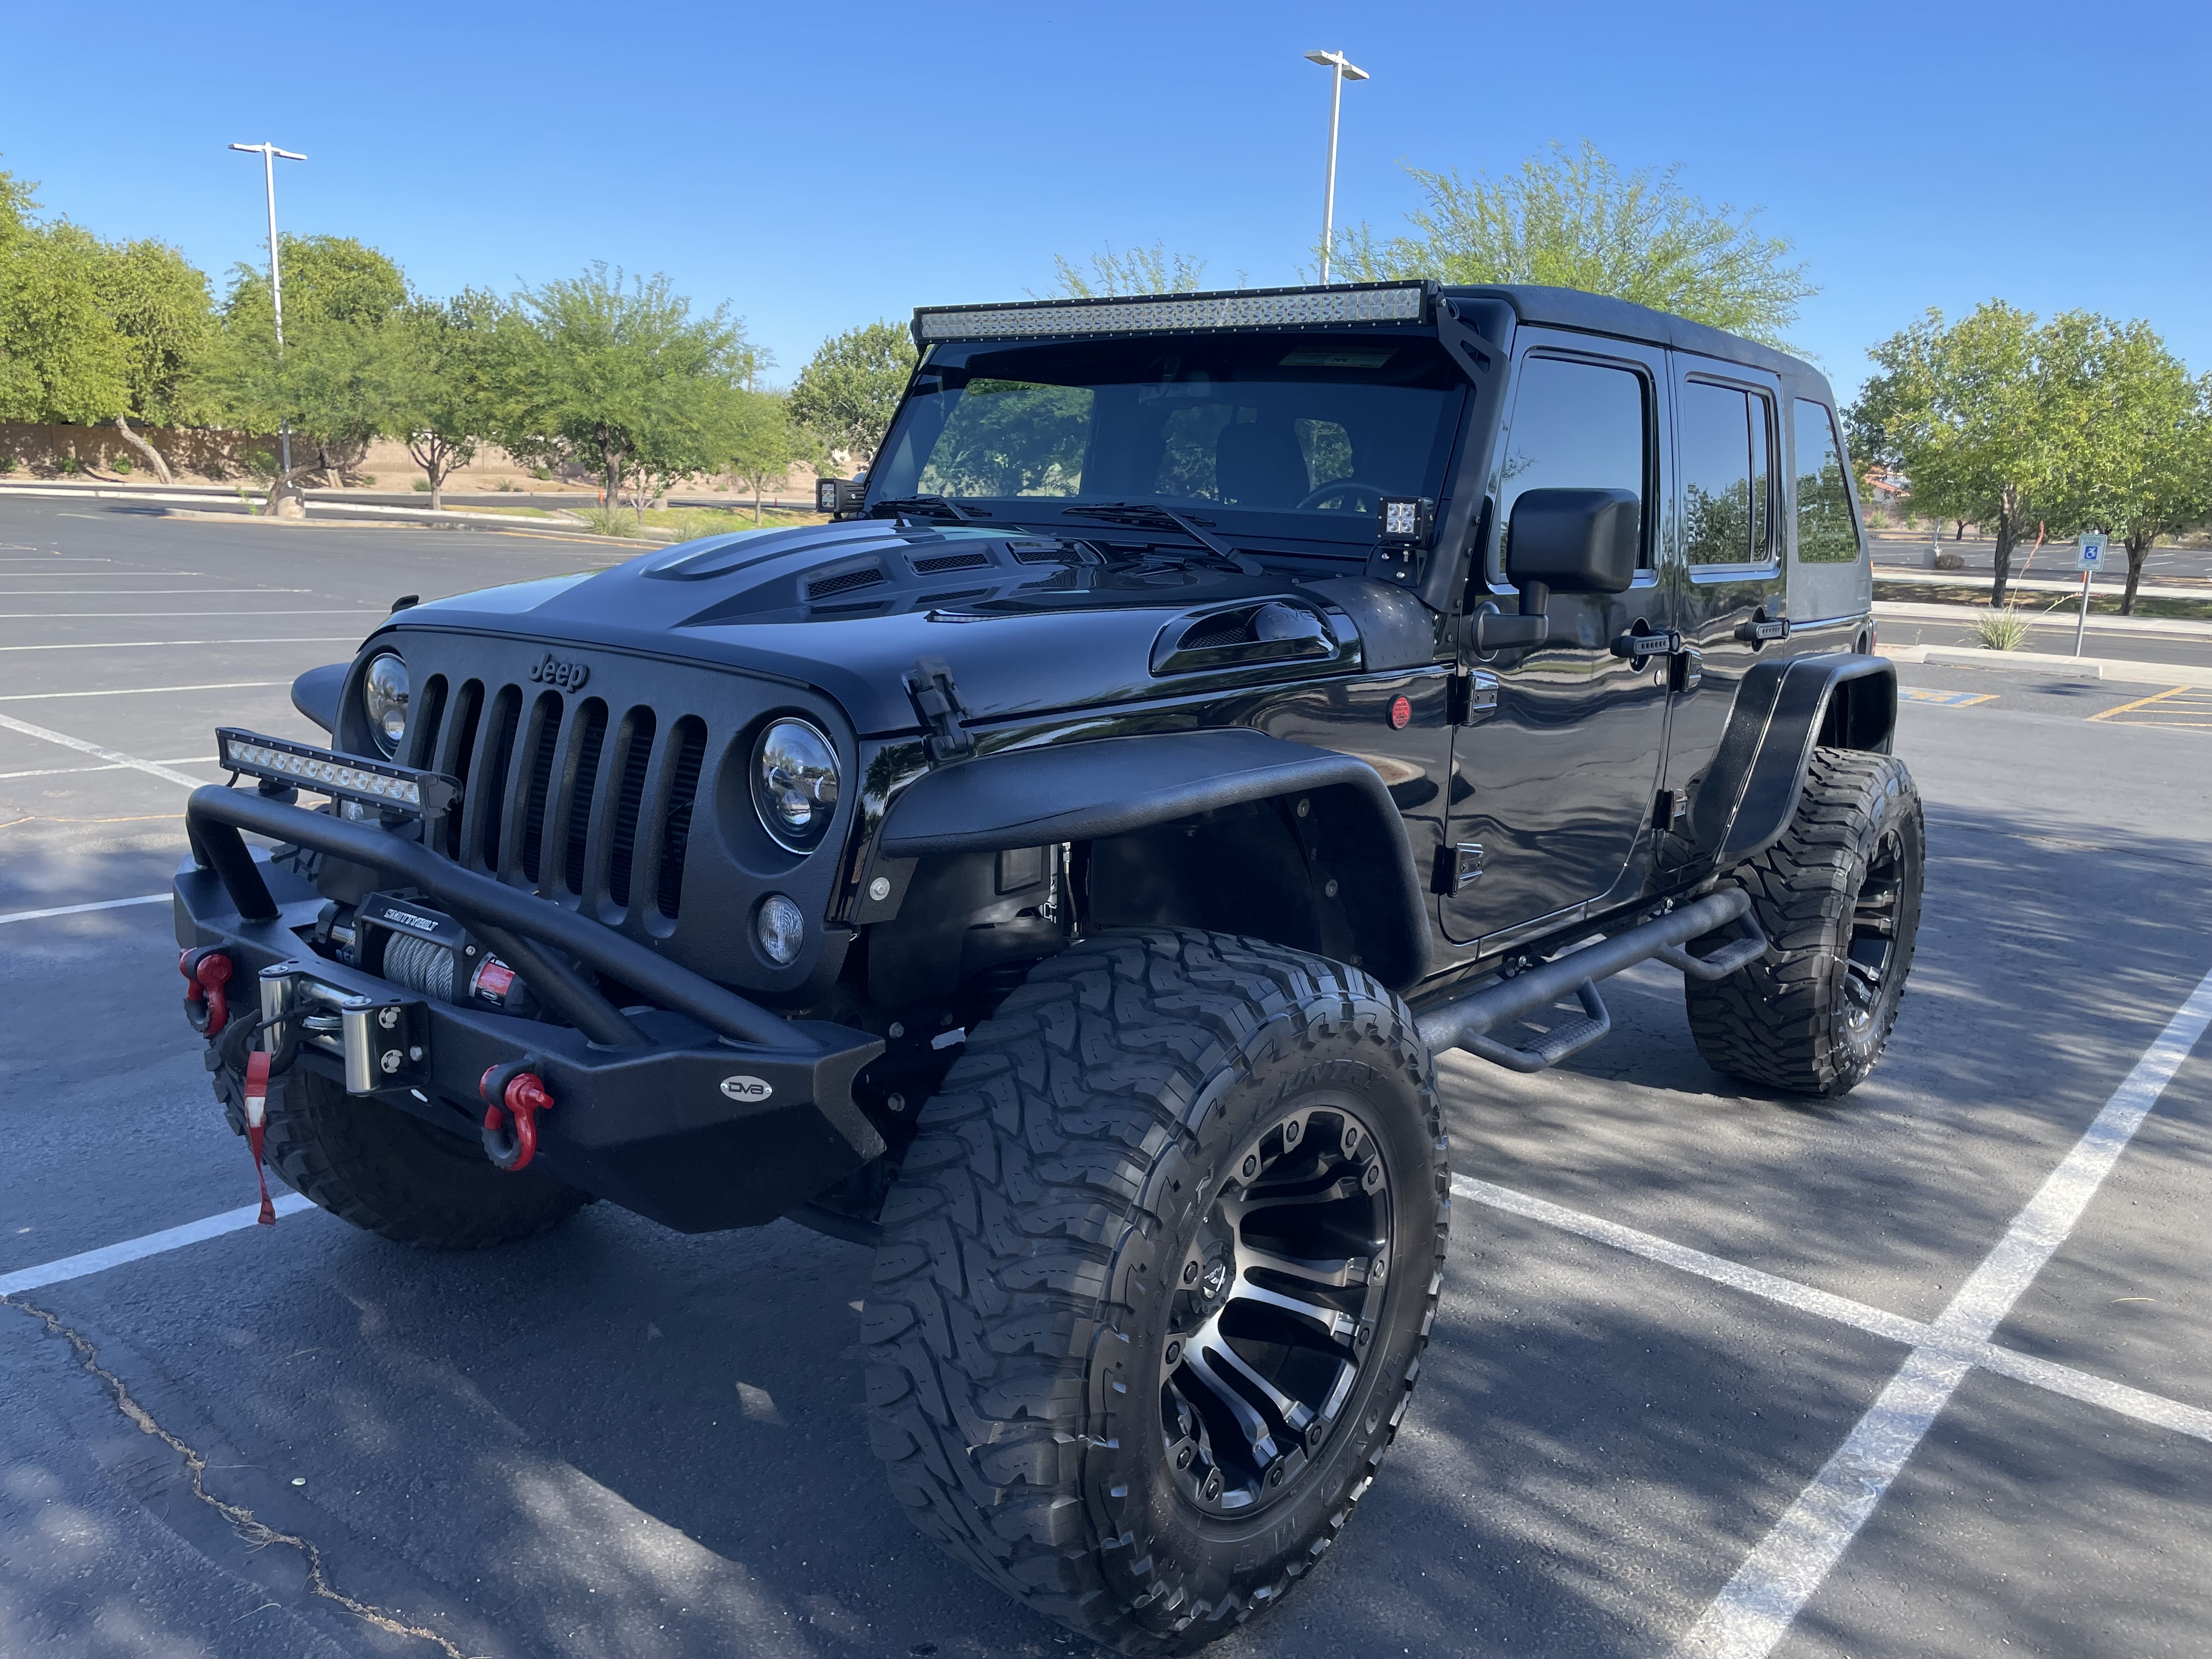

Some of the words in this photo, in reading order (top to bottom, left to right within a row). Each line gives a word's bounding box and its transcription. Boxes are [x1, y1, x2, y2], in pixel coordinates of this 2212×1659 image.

[529, 653, 590, 693] Jeep
[384, 909, 438, 932] SMITTYBILT
[1318, 1350, 1404, 1511] TOYO
